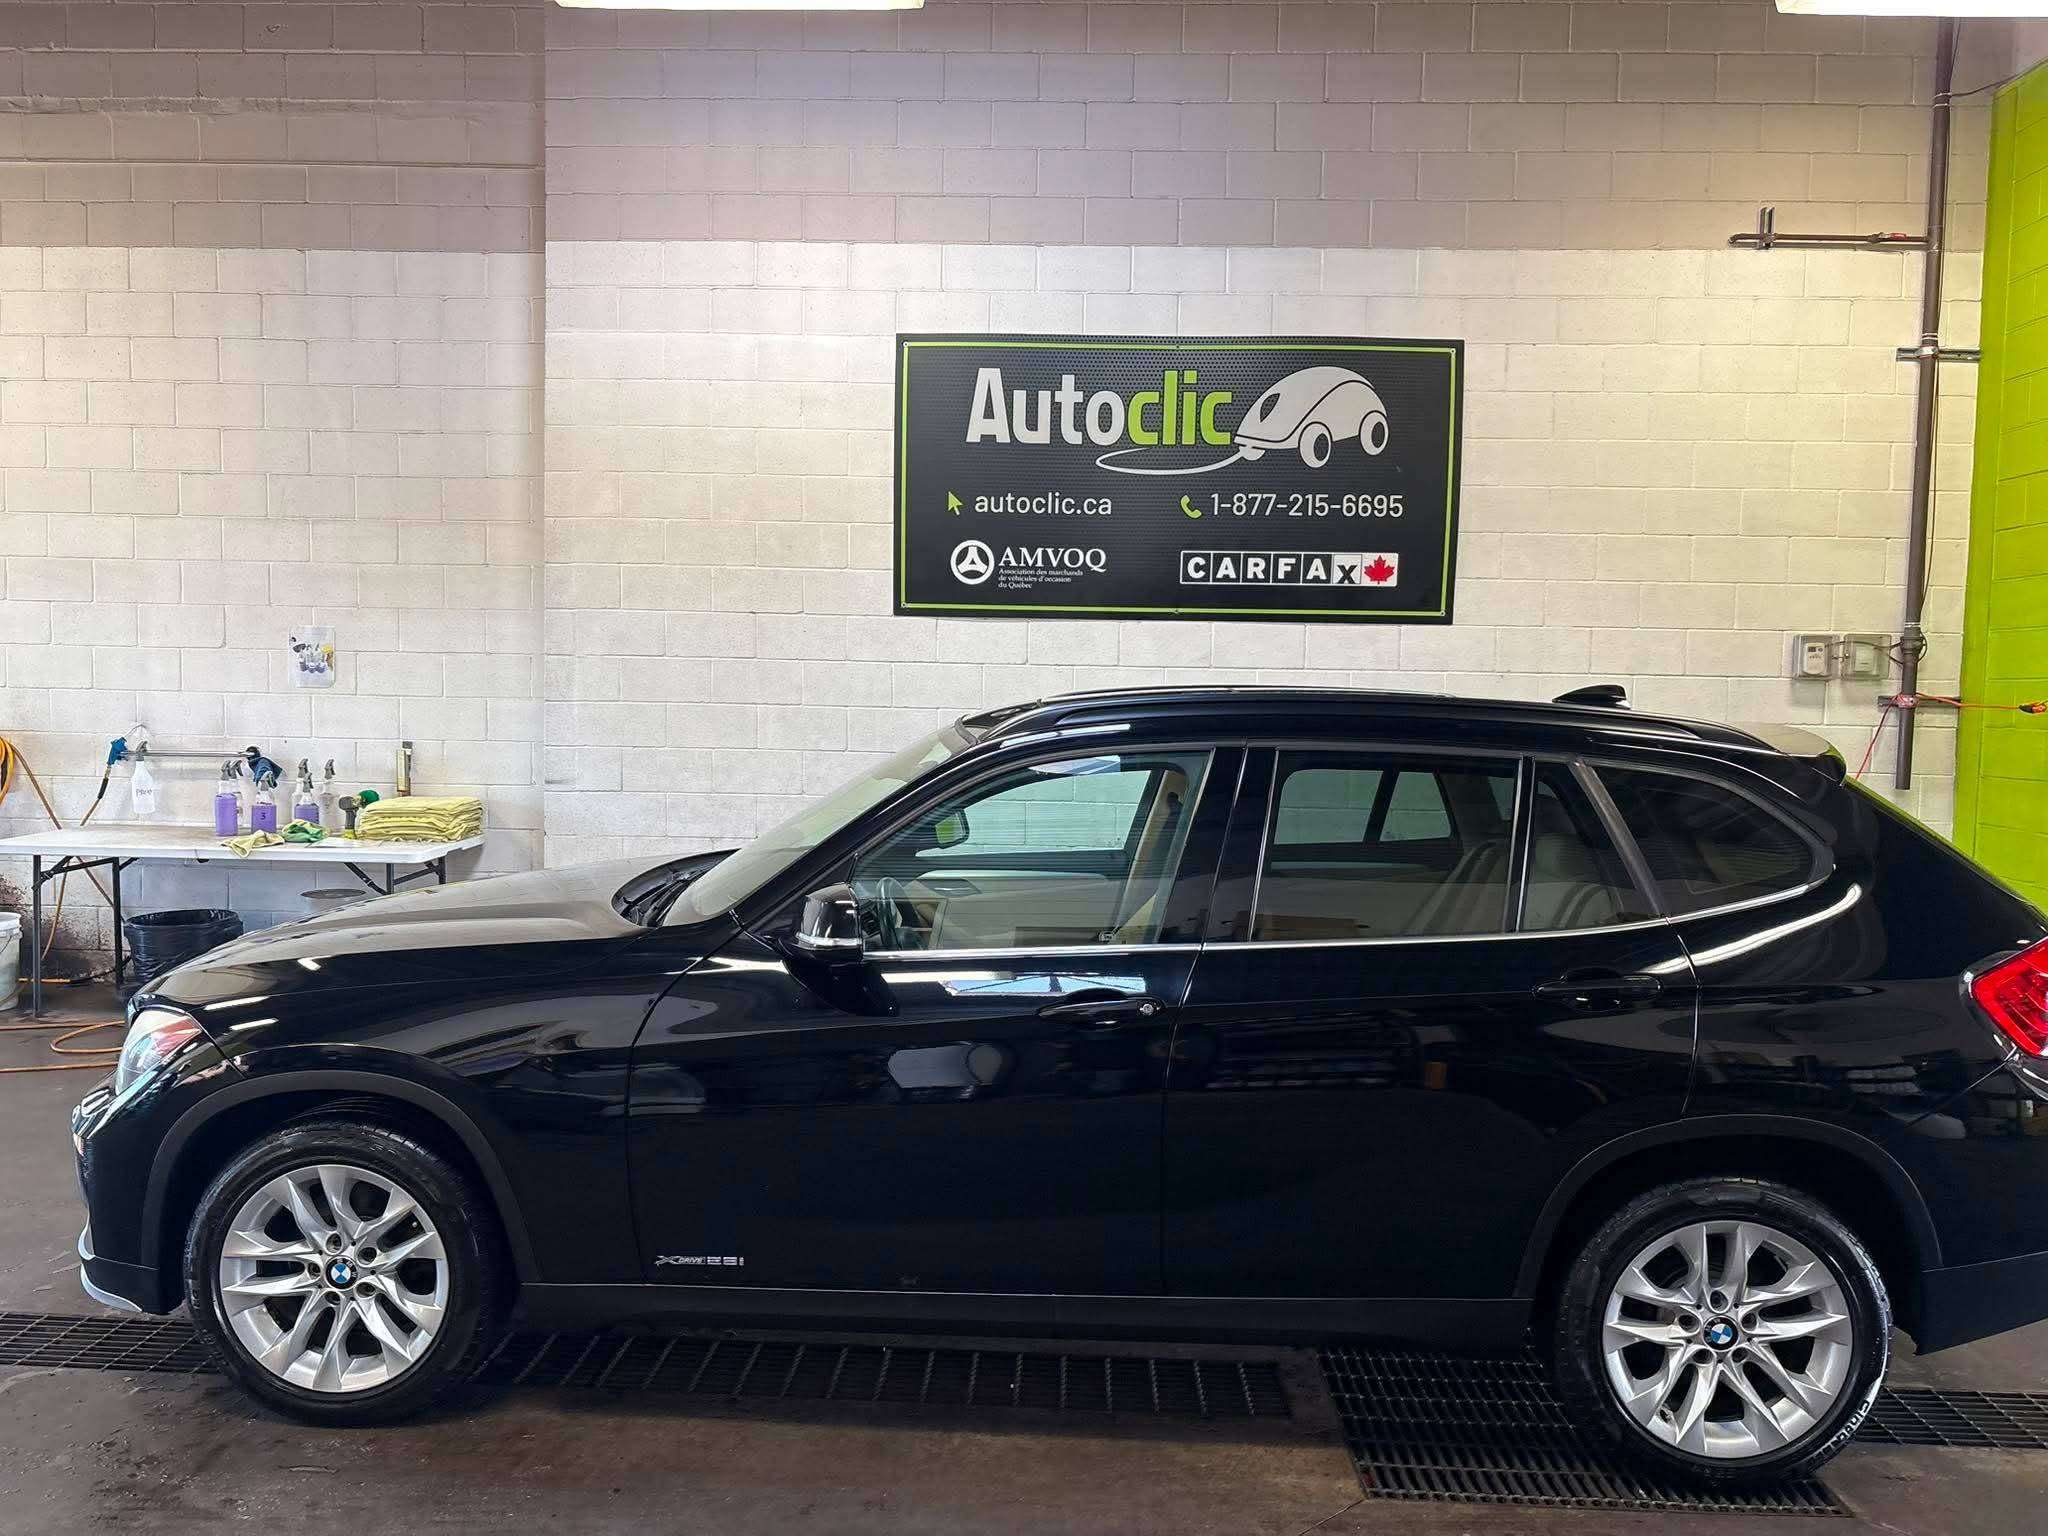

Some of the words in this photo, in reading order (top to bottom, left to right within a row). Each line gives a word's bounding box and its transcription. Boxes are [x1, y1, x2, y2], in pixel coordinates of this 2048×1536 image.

[965, 367, 1233, 446] Autoclic
[974, 492, 1112, 515] autoclic.ca
[1210, 493, 1403, 518] 1-877-215-6695
[998, 546, 1107, 573] AMVOQ
[1186, 556, 1356, 584] CARFAX
